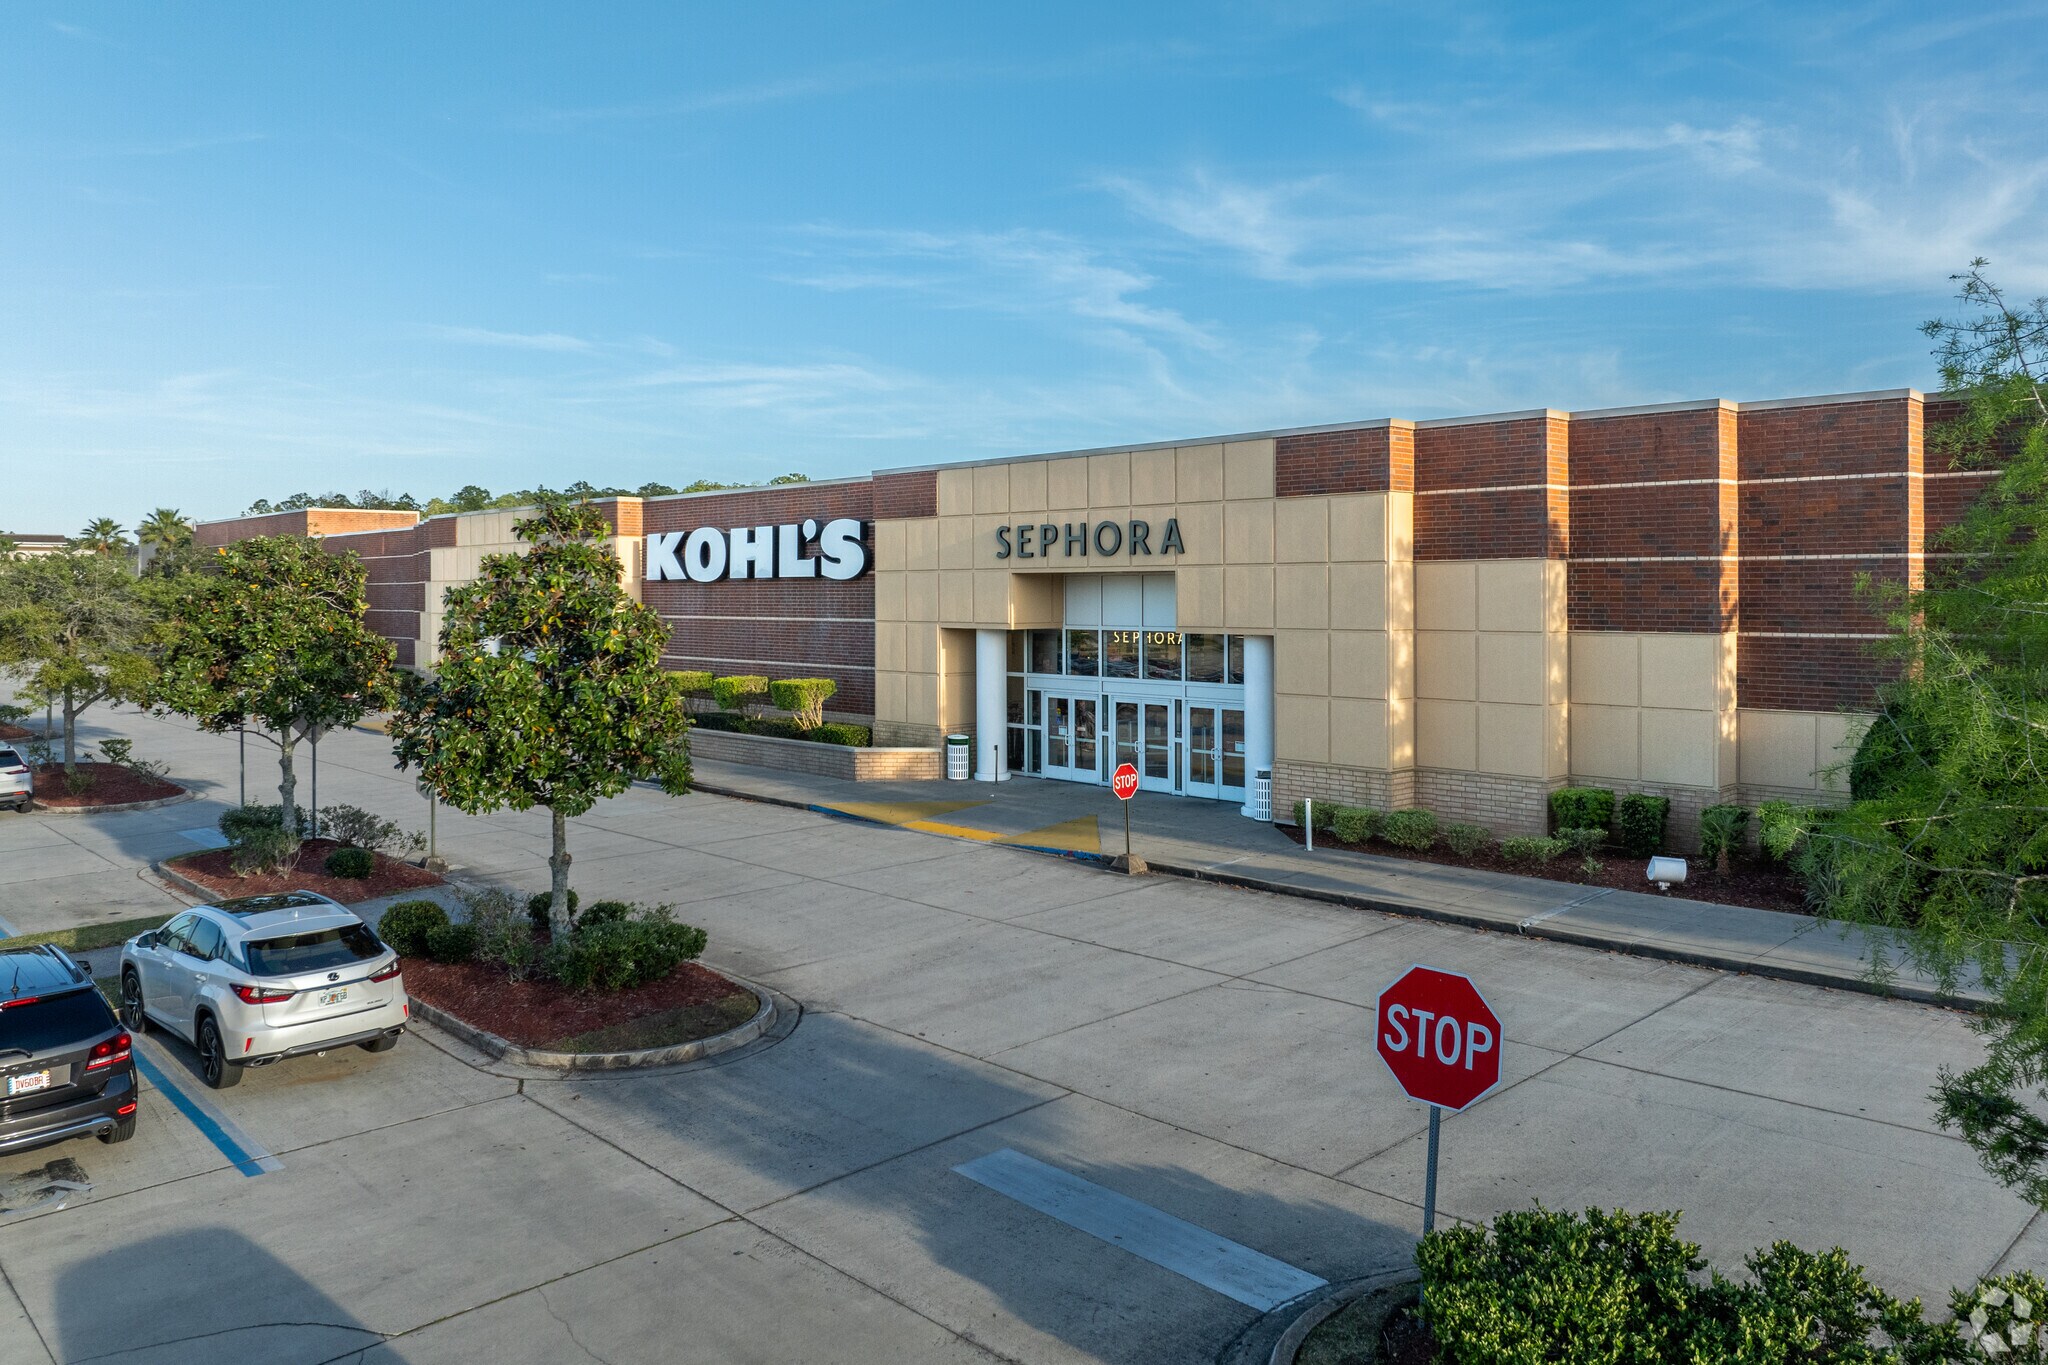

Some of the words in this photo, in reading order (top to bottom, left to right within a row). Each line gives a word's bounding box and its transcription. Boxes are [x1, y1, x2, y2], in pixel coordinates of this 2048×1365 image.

[646, 518, 867, 583] KOHL'S
[996, 518, 1185, 559] SEPHORA
[1115, 773, 1137, 790] STOP
[1384, 1003, 1493, 1071] STOP
